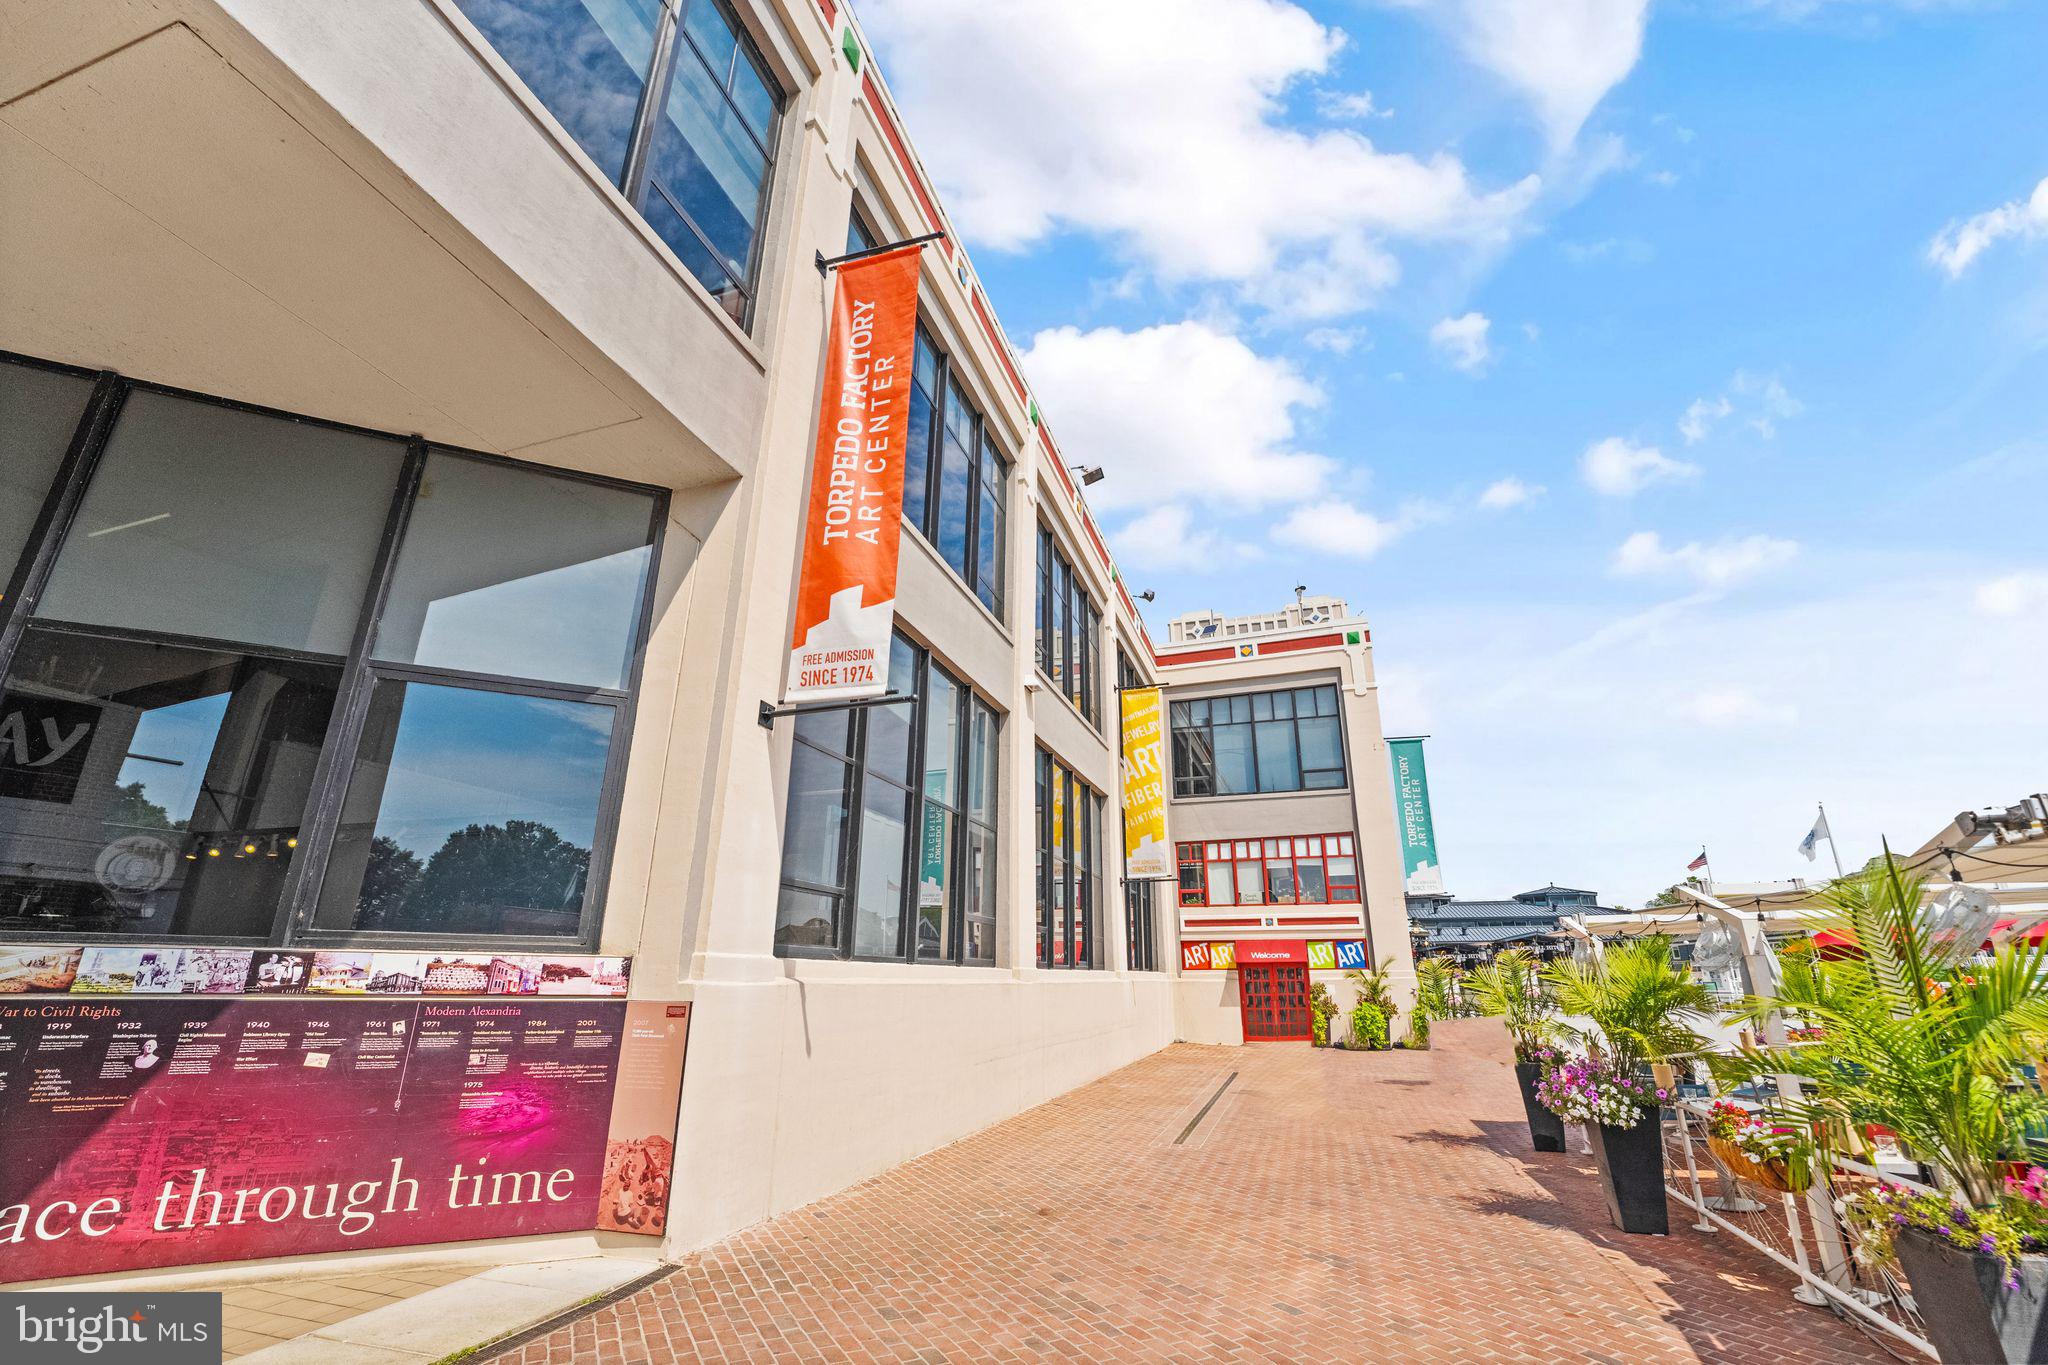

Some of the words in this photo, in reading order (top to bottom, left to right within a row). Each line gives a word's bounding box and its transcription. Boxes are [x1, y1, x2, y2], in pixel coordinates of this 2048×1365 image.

[840, 299, 876, 410] FACTORY
[863, 355, 896, 474] CENTER
[823, 418, 864, 546] TORPEDO
[855, 486, 884, 545] ART
[802, 652, 823, 667] FREE
[824, 648, 875, 665] ADMISSION
[800, 667, 838, 687] SINCE
[842, 665, 874, 684] 1974
[1123, 741, 1164, 785] ART
[1398, 755, 1412, 799] FACTORY
[1123, 782, 1163, 810] FIBER
[1411, 778, 1425, 822] CENTER
[1404, 801, 1419, 847] TORPEDO
[1417, 826, 1428, 847] ART
[1183, 942, 1210, 969] ART
[1210, 942, 1236, 969] ART
[1250, 951, 1291, 960] Welcome
[1307, 941, 1335, 968] ART
[1336, 940, 1366, 969] ART
[23, 1007, 37, 1018] to
[41, 1005, 76, 1018] Civil
[79, 1005, 122, 1020] Rights
[425, 1006, 466, 1016] Modern
[469, 1006, 521, 1016] Alexandria
[46, 1022, 73, 1030] 1919
[117, 1022, 142, 1030] 1932
[183, 1021, 208, 1029] 1939
[246, 1021, 270, 1029] 1940
[154, 1158, 420, 1236] through
[447, 1157, 575, 1210] time
